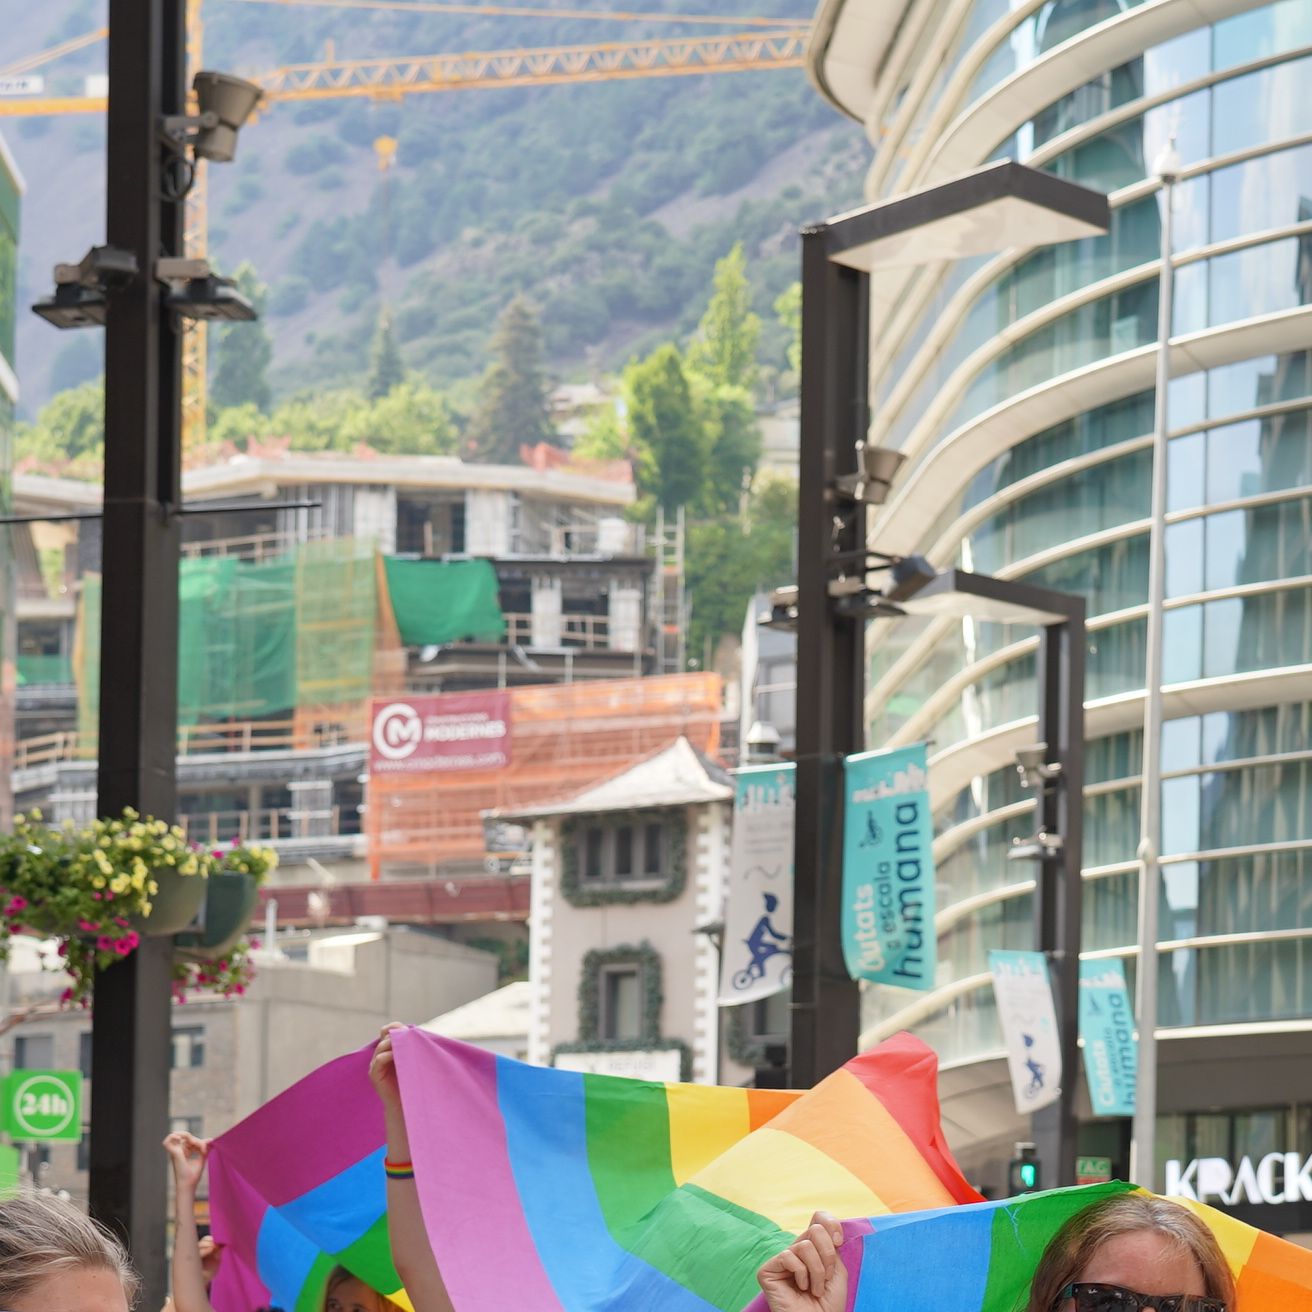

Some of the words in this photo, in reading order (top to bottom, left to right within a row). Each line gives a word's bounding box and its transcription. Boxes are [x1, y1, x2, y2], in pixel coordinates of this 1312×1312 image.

[873, 860, 897, 934] escala
[892, 800, 923, 980] humana
[21, 1092, 68, 1117] 24h
